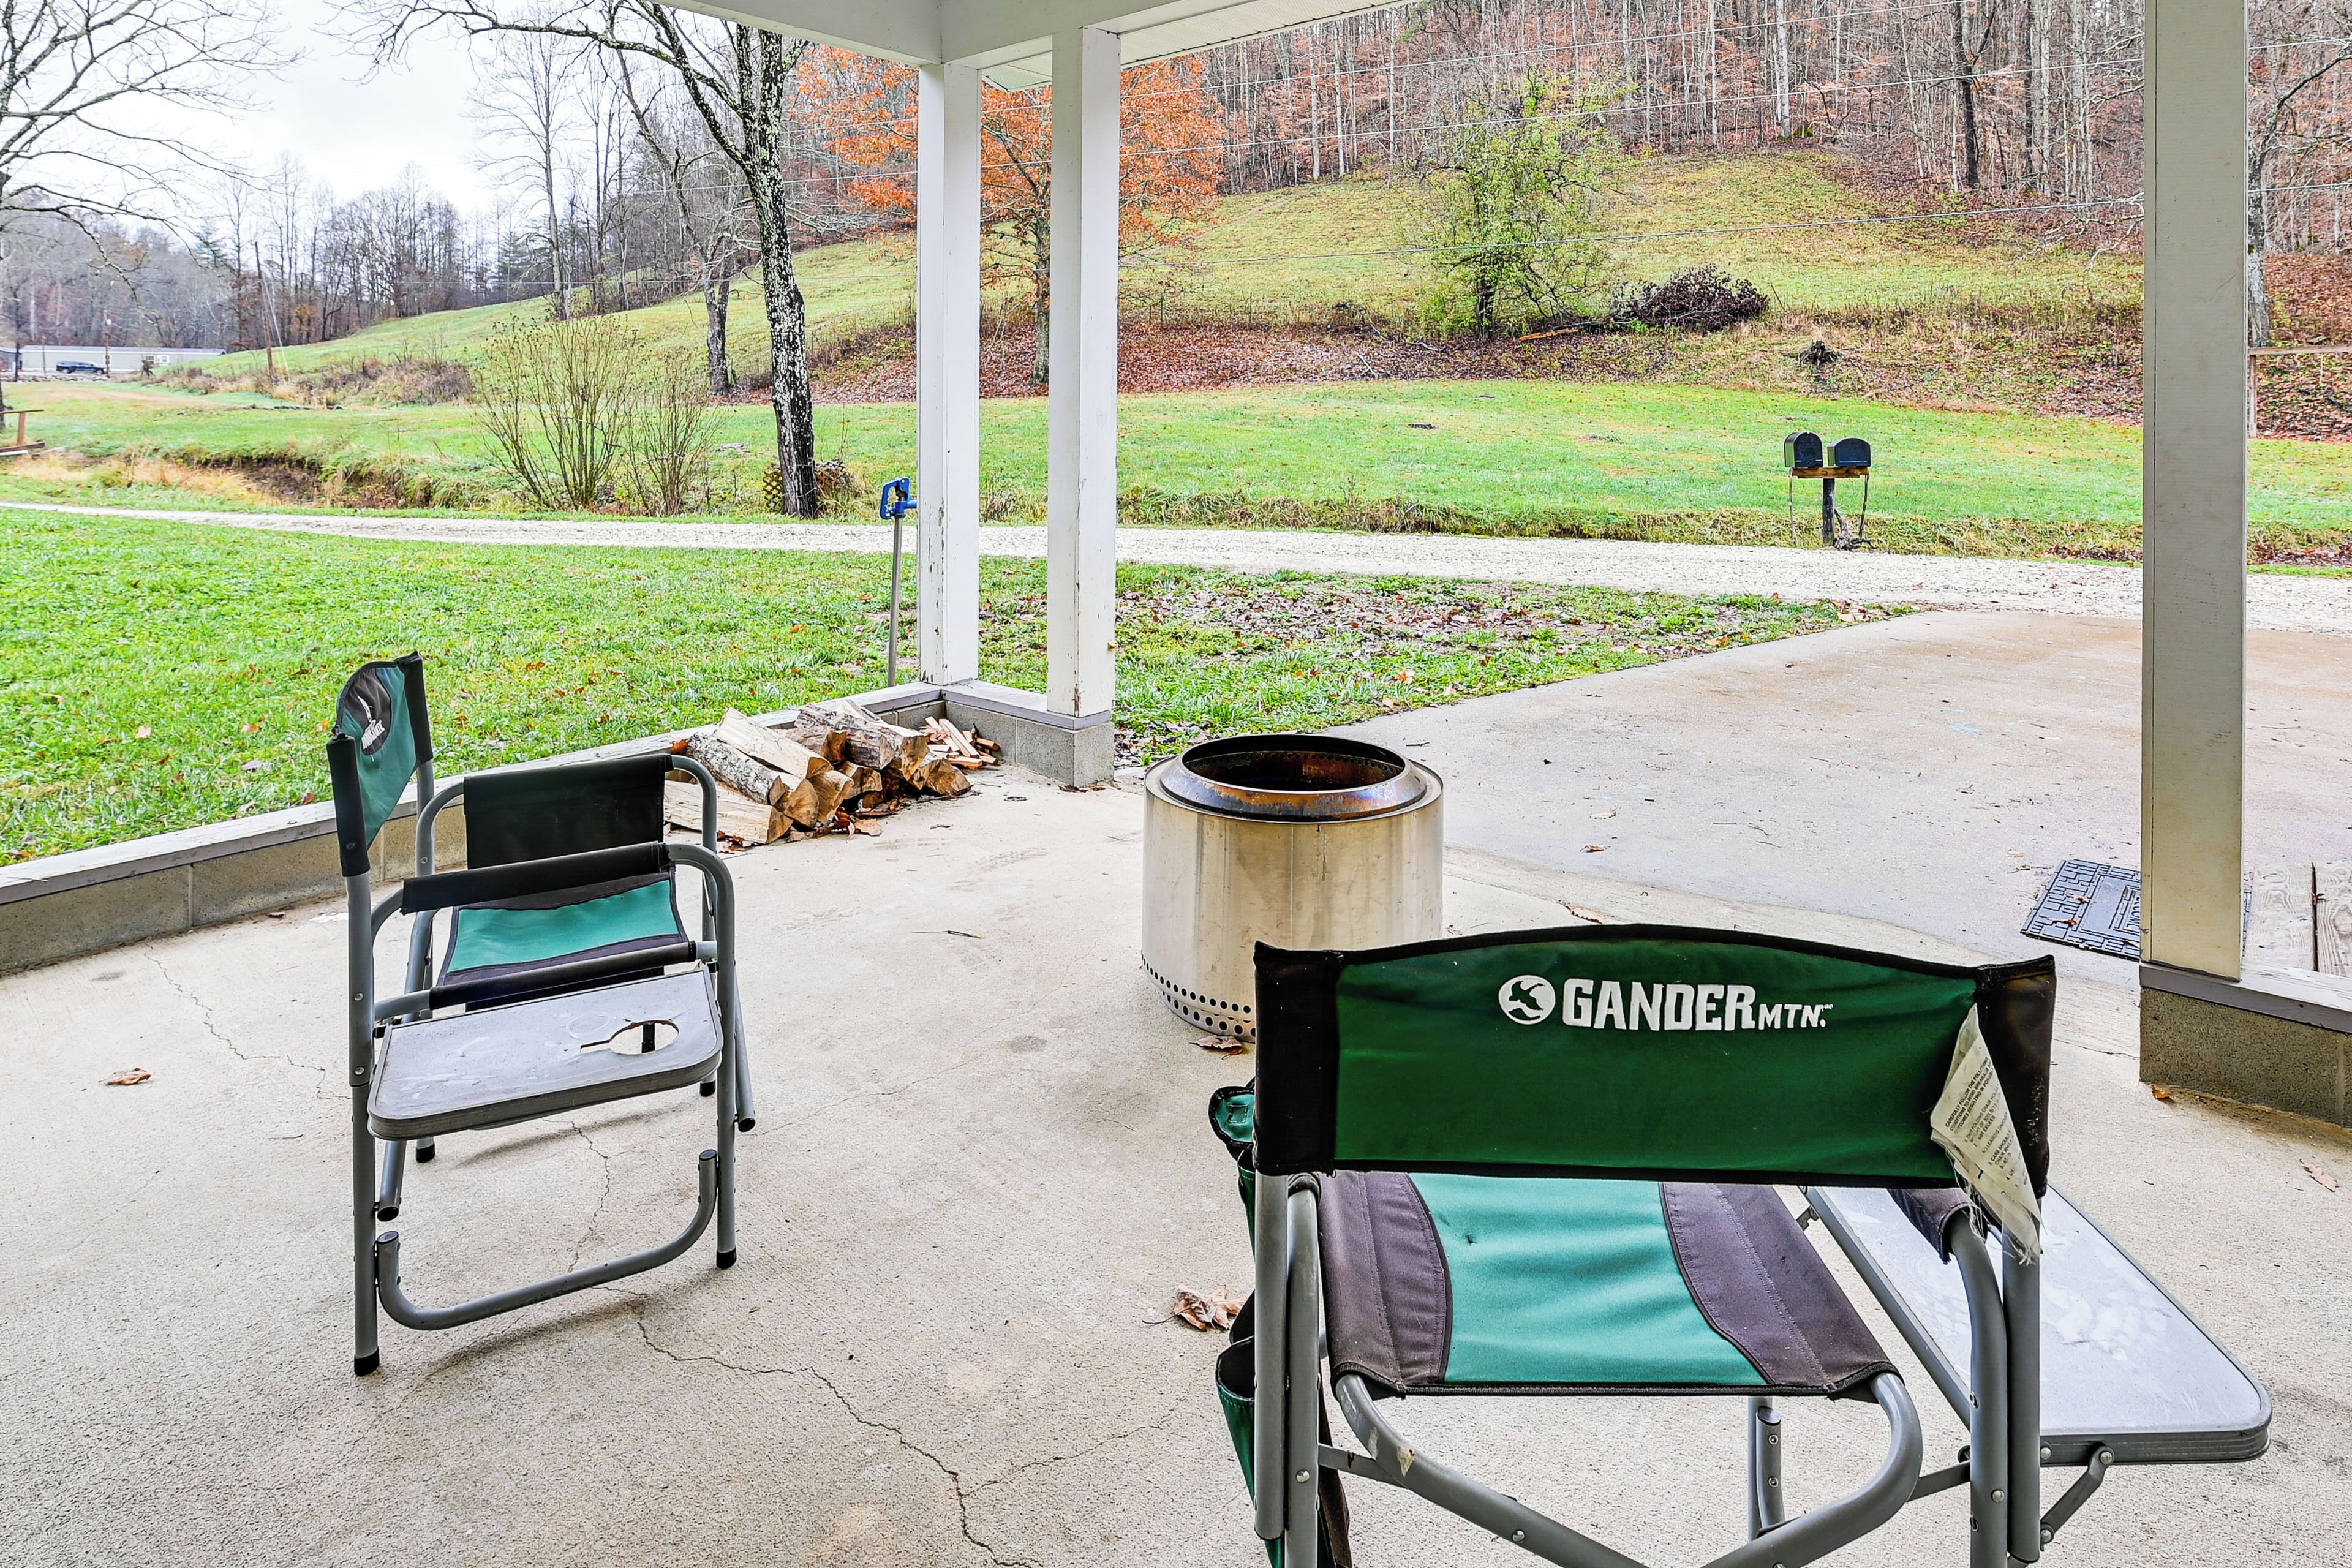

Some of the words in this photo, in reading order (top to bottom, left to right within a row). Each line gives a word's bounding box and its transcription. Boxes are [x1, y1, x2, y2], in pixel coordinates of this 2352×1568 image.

[1562, 978, 1755, 1031] GANDER
[1966, 1089, 1976, 1101] AVOID
[1973, 1067, 1990, 1090] BREAKAE
[1966, 1091, 1981, 1113] RESULTING
[1944, 1104, 1961, 1128] CAREFULLY
[1970, 1111, 1984, 1129] FOLDING
[1981, 1099, 1992, 1113] CHAIR
[1982, 1114, 1996, 1132] EXCEED
[1990, 1148, 2000, 1161] CARE
[1994, 1151, 2005, 1165] CHAIR
